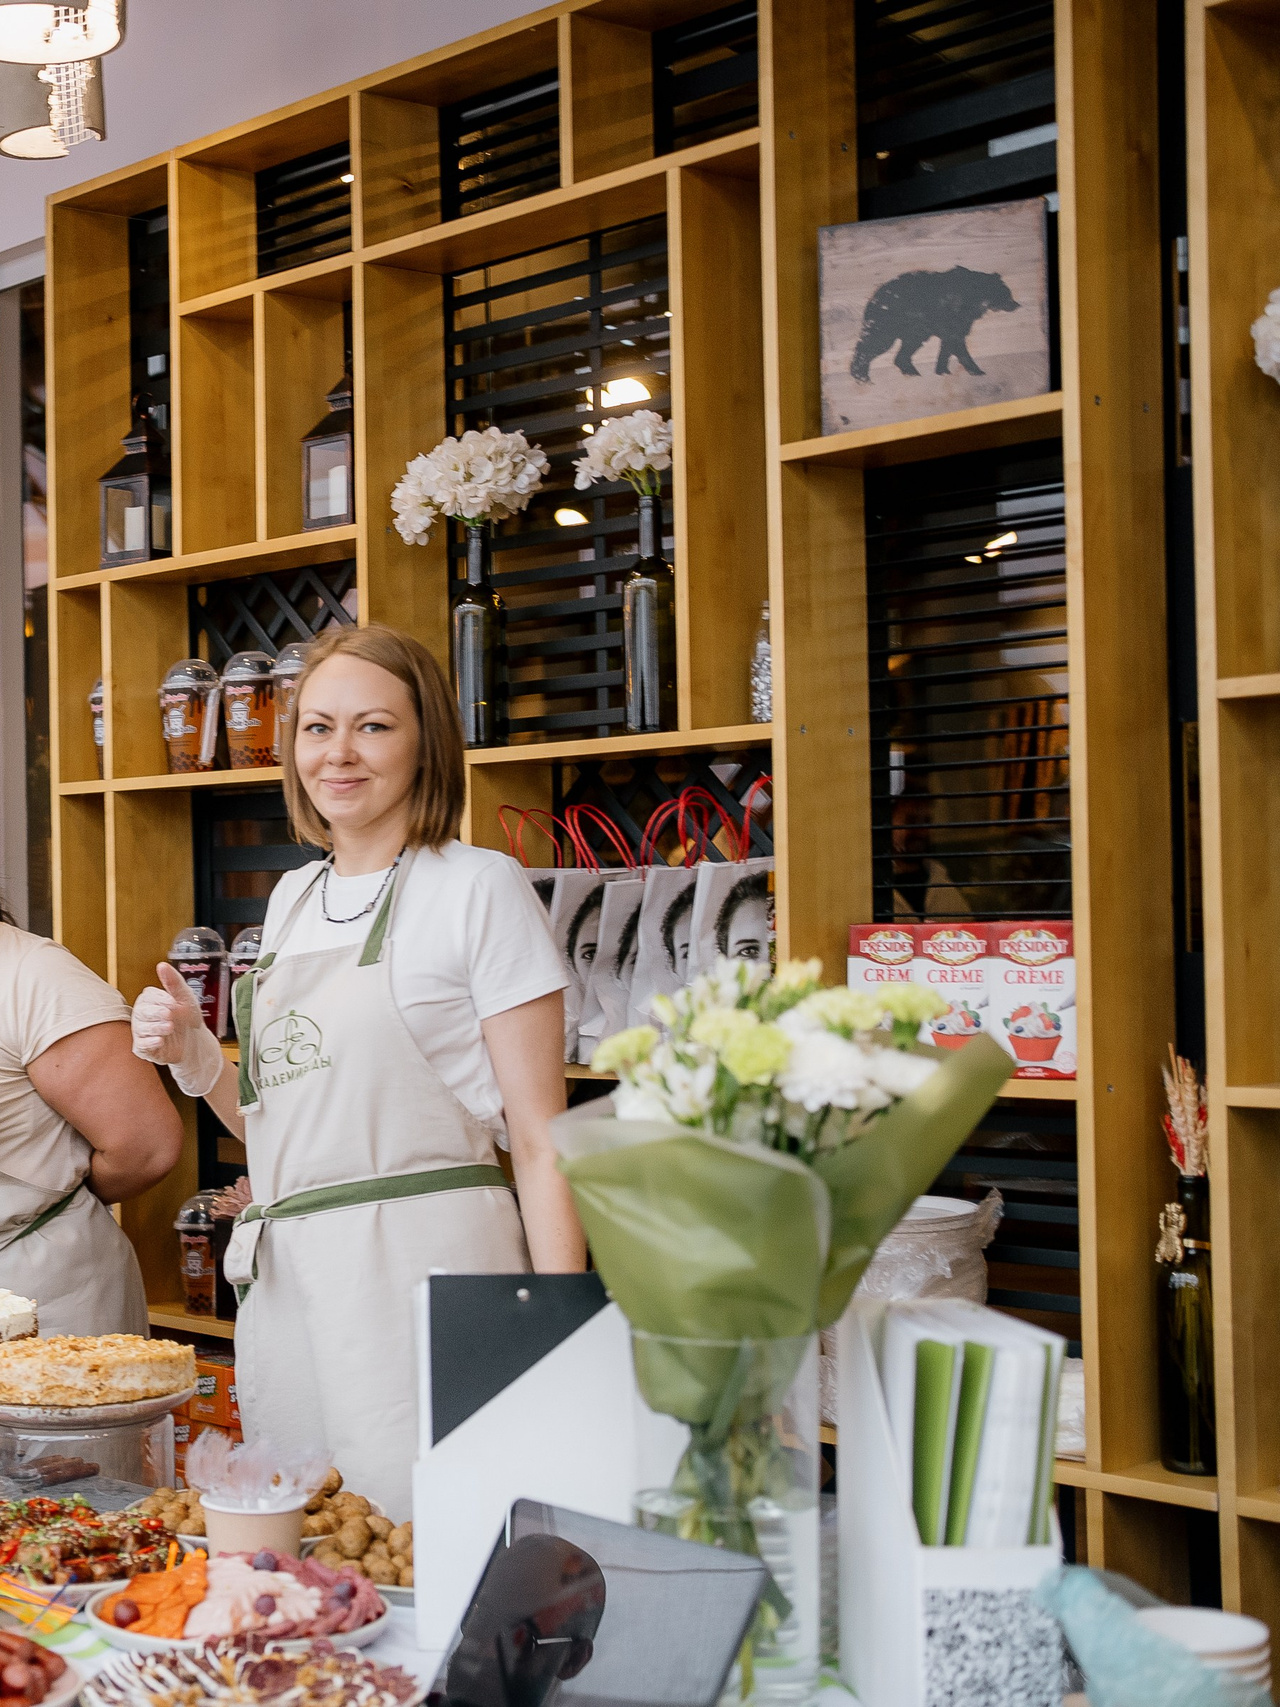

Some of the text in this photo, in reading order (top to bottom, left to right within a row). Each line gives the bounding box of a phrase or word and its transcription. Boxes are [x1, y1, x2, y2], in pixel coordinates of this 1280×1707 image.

[860, 940, 914, 954] PRÉSIDEN
[922, 940, 987, 954] PRÉSIDENT
[999, 939, 1068, 955] PRÉSIDENT
[863, 967, 913, 983] CRÈM
[927, 967, 984, 984] CRÈME
[1004, 967, 1064, 985] CRÈME
[258, 1065, 310, 1091] КАДЕМИЯ
